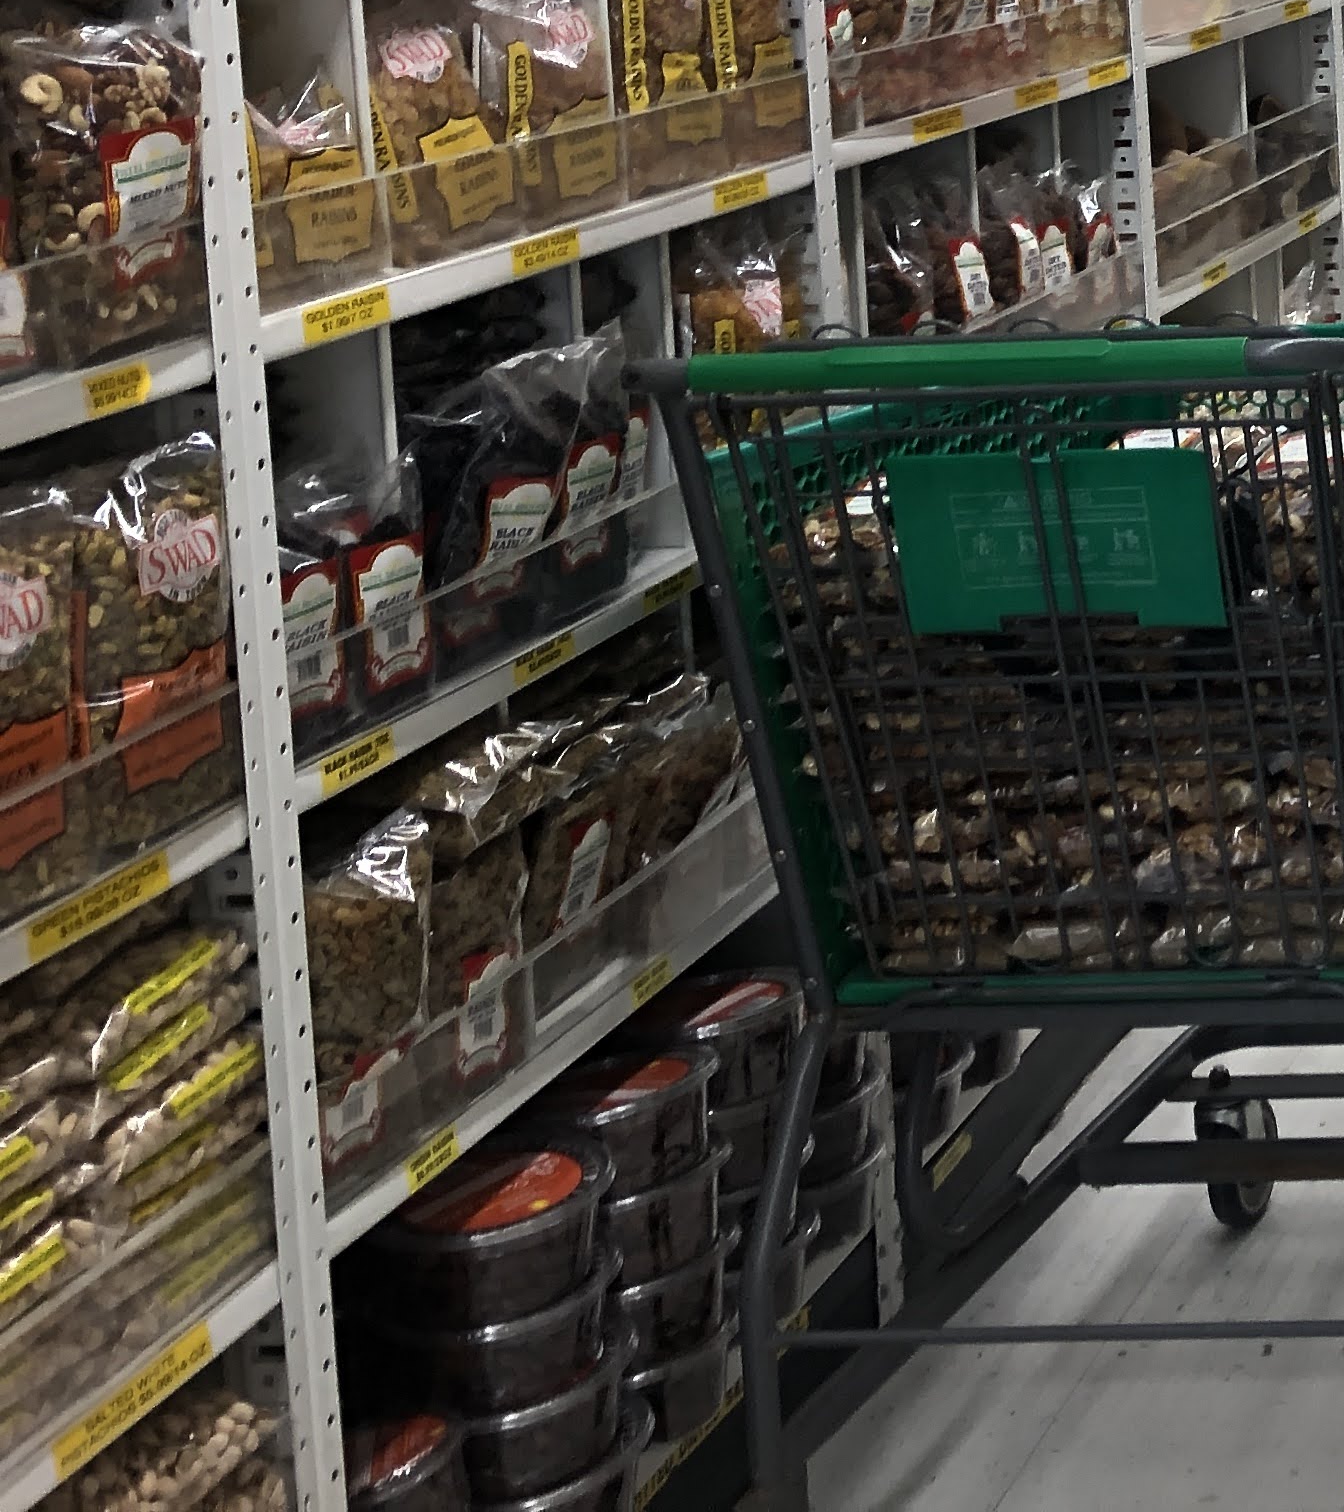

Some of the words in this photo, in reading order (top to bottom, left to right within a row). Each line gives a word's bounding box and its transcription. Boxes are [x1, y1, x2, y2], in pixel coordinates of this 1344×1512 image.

[305, 303, 350, 325] GOLDEN
[496, 526, 535, 539] BLACK
[148, 528, 217, 585] SWAD
[30, 904, 80, 938] GREEN
[82, 859, 161, 908] PISTACHIOS
